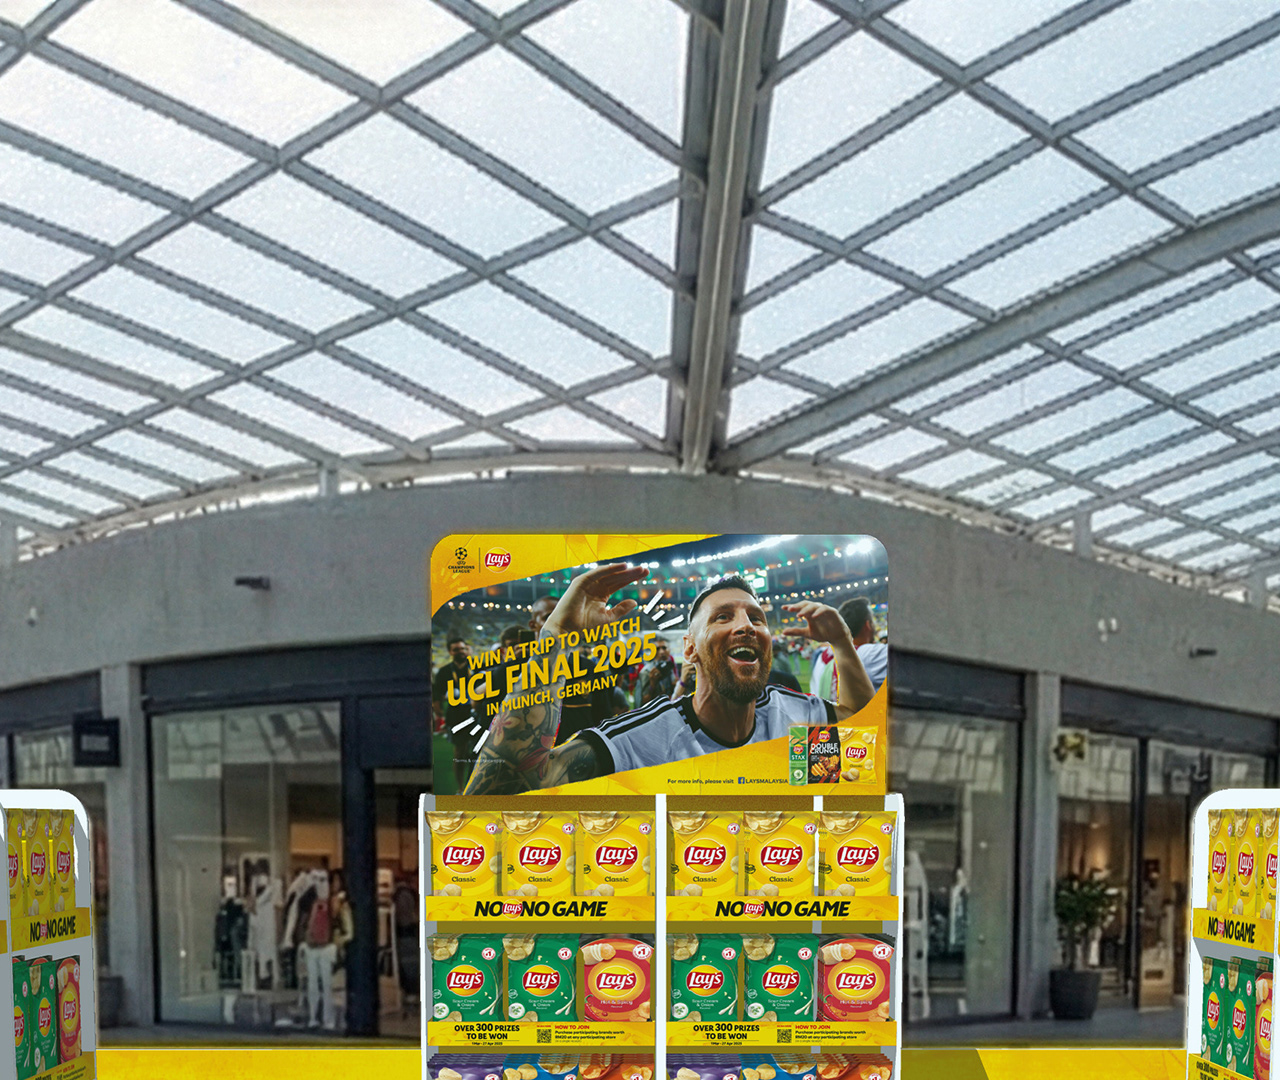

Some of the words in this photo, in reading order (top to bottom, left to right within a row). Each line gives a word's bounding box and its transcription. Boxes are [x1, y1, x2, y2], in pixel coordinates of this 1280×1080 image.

[486, 553, 509, 568] Lay's
[467, 650, 501, 671] WIN
[504, 646, 517, 663] A
[518, 637, 555, 659] TRIP
[558, 631, 580, 649] TO
[582, 616, 641, 643] WATCH
[447, 670, 500, 707] UCL
[506, 650, 588, 694] FINAL
[593, 633, 657, 673] 2025
[486, 701, 500, 716] IN
[502, 690, 555, 714] MUNICH,
[556, 674, 619, 699] GERMANY
[846, 747, 867, 759] Lay's
[446, 847, 482, 866] Lay's
[522, 847, 559, 866] Lay's
[599, 847, 635, 866] Lay's
[687, 847, 724, 866] Lay's
[764, 847, 800, 866] Lay's
[840, 847, 877, 866] Lay's
[474, 901, 503, 917] NO
[503, 903, 522, 914] Lay's
[521, 901, 550, 917] NO
[552, 901, 608, 917] GAME
[715, 901, 744, 917] NO
[744, 903, 764, 914] Lay's
[762, 901, 792, 917] NO
[794, 901, 851, 917] GAME
[449, 973, 482, 990] Lay's
[525, 973, 558, 990] Lay's
[598, 973, 634, 990] Lay's
[689, 973, 722, 990] Lay's
[765, 973, 797, 990] Lay's
[838, 973, 874, 990] Lay's
[476, 1023, 493, 1032] 300
